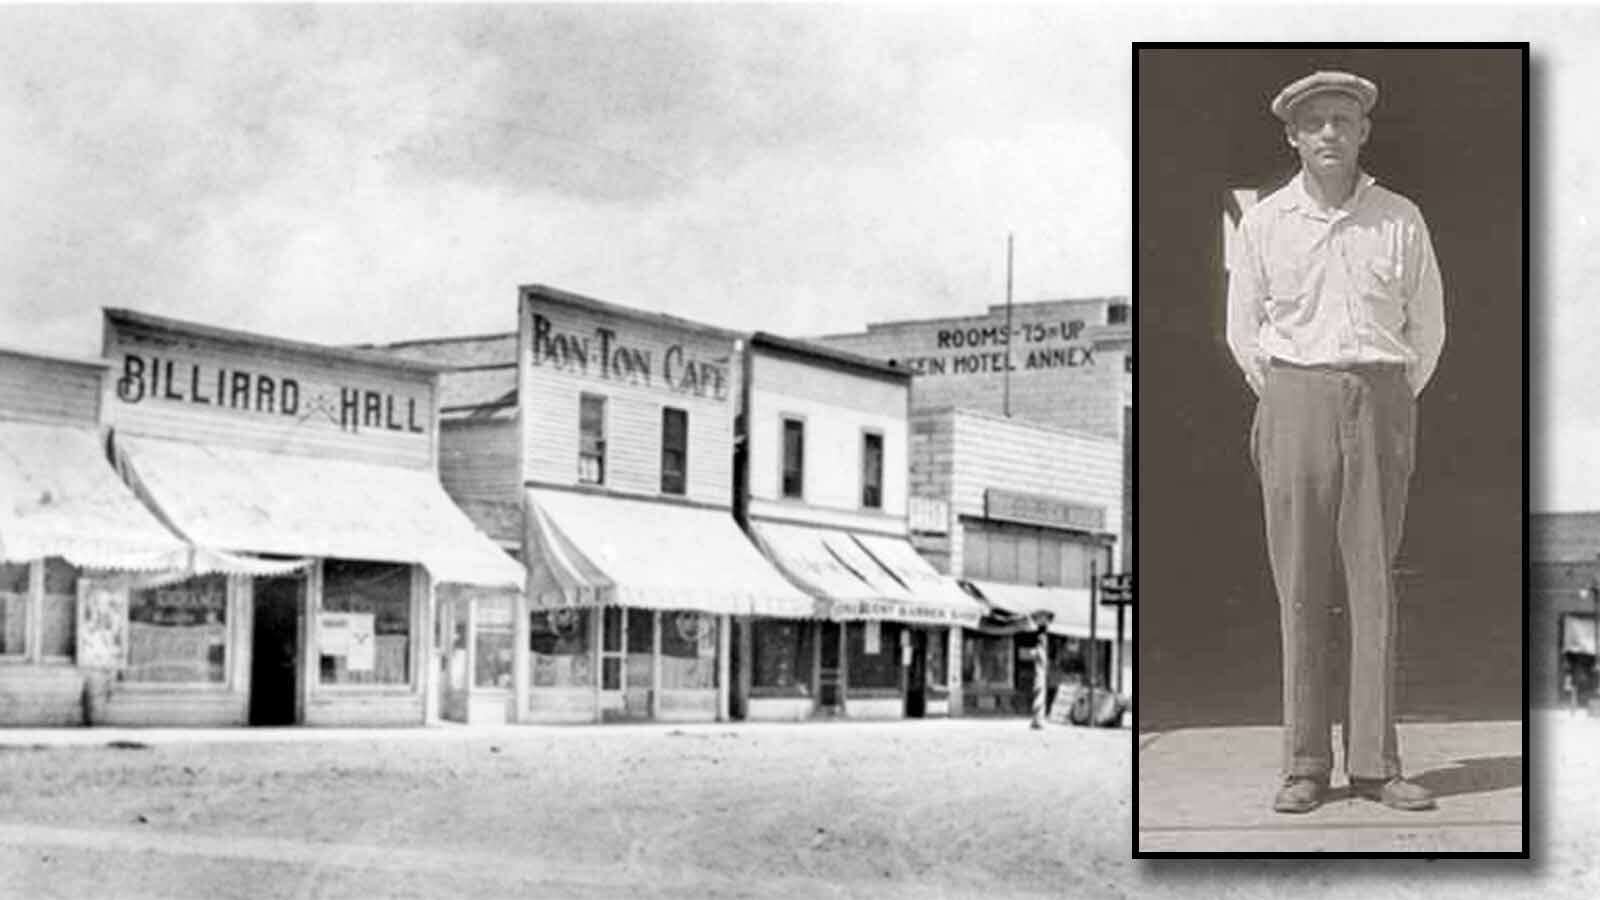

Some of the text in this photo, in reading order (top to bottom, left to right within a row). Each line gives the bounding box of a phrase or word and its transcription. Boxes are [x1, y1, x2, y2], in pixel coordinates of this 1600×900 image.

[953, 351, 1016, 374] HOTEL
[1025, 345, 1096, 370] ANNEX
[117, 353, 424, 433] BILLIARD HALL
